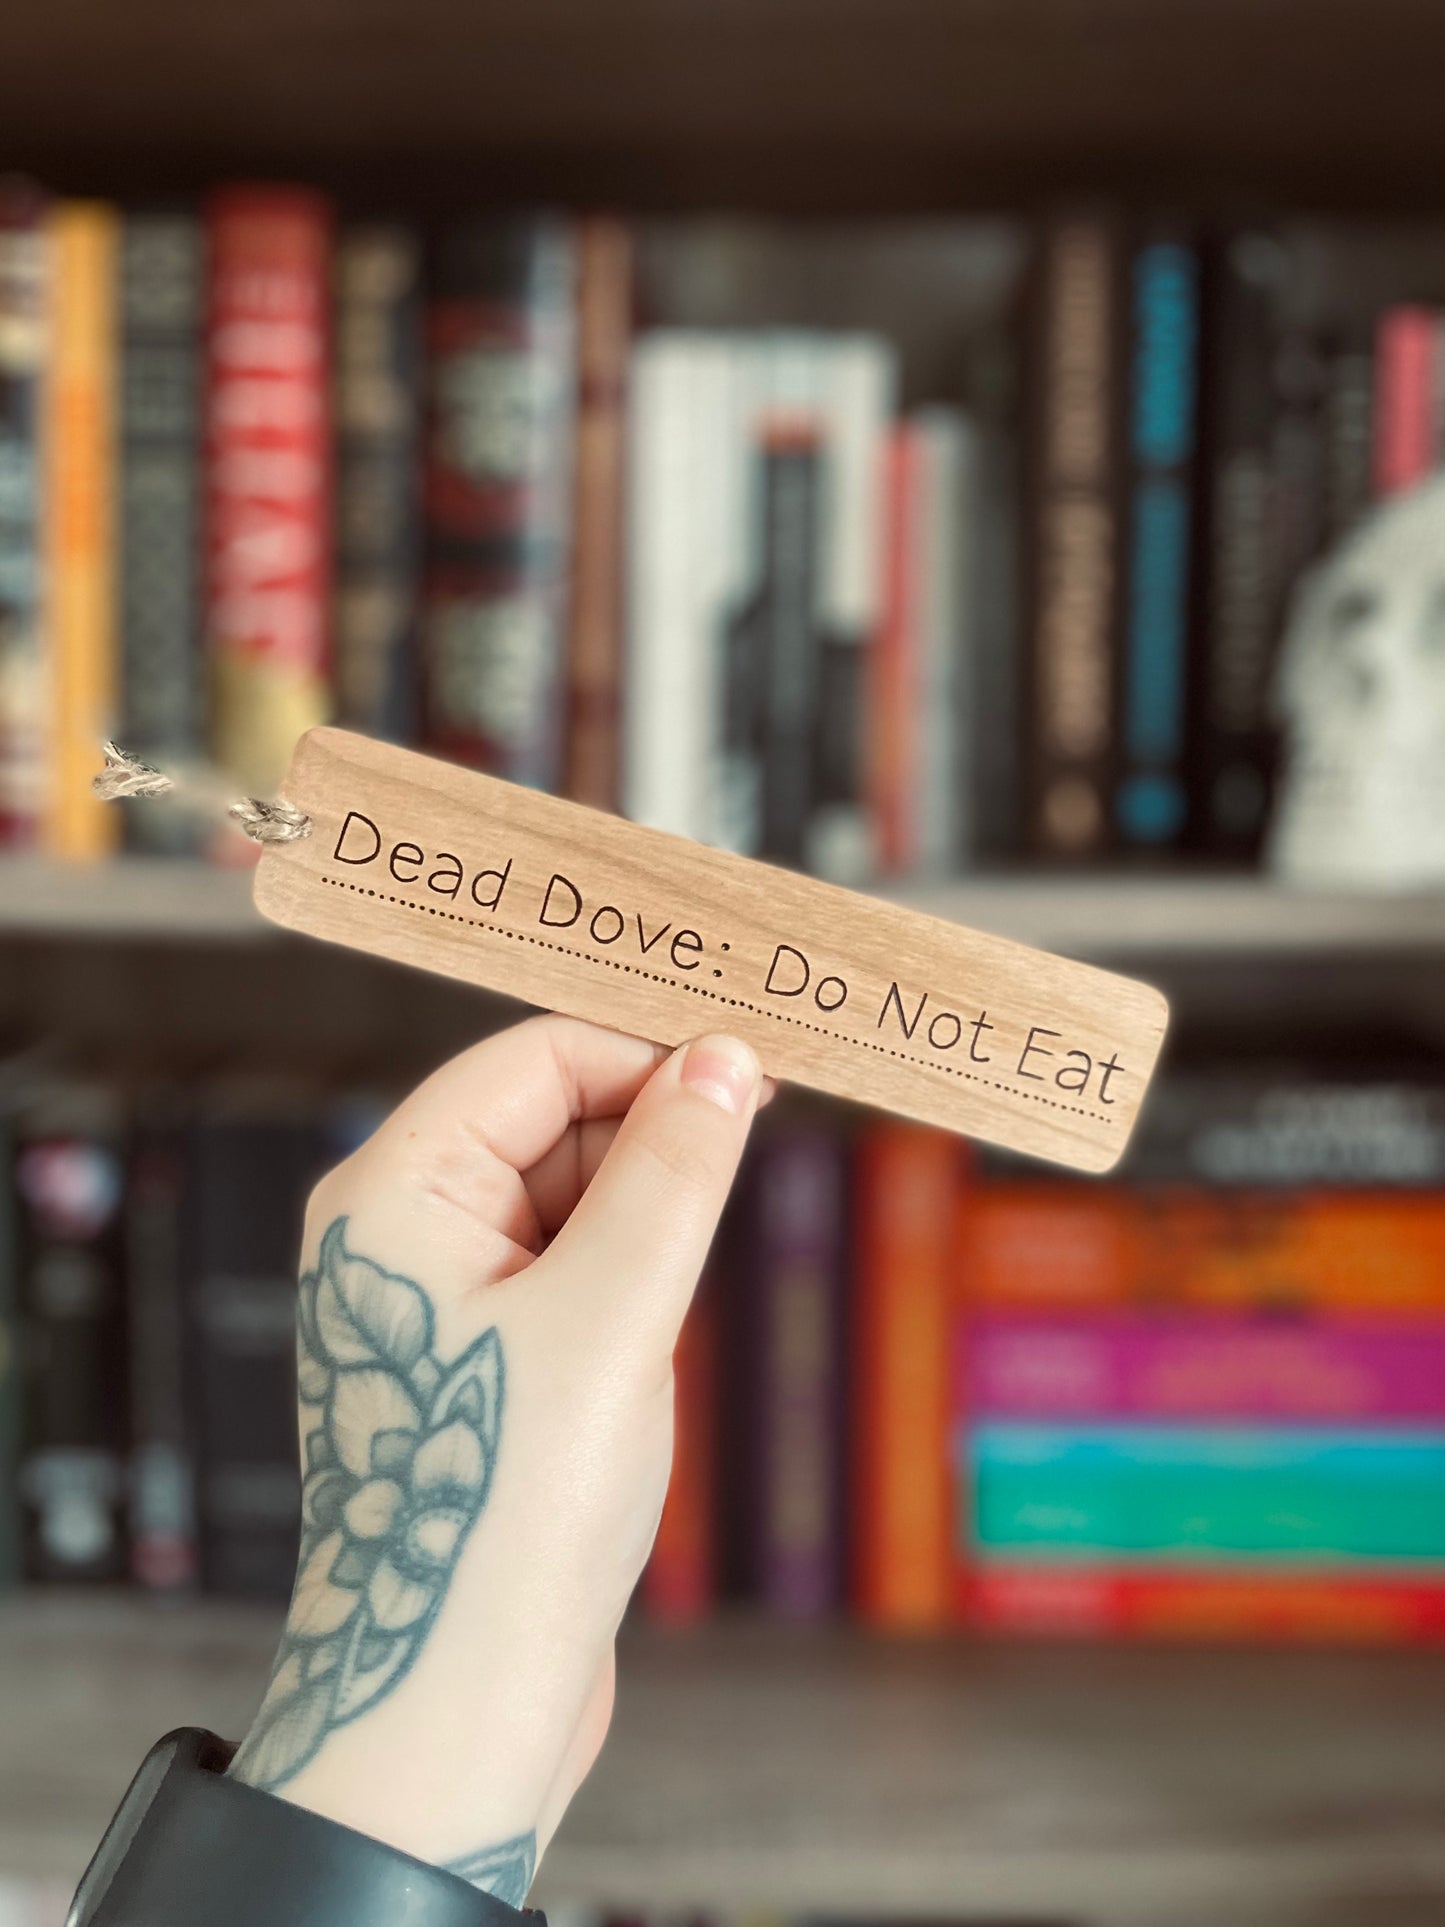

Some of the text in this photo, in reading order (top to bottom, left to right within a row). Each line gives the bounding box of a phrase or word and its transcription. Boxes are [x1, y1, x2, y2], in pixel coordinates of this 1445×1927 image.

[333, 811, 1125, 1105] Dead Dove: Do Not Eat
